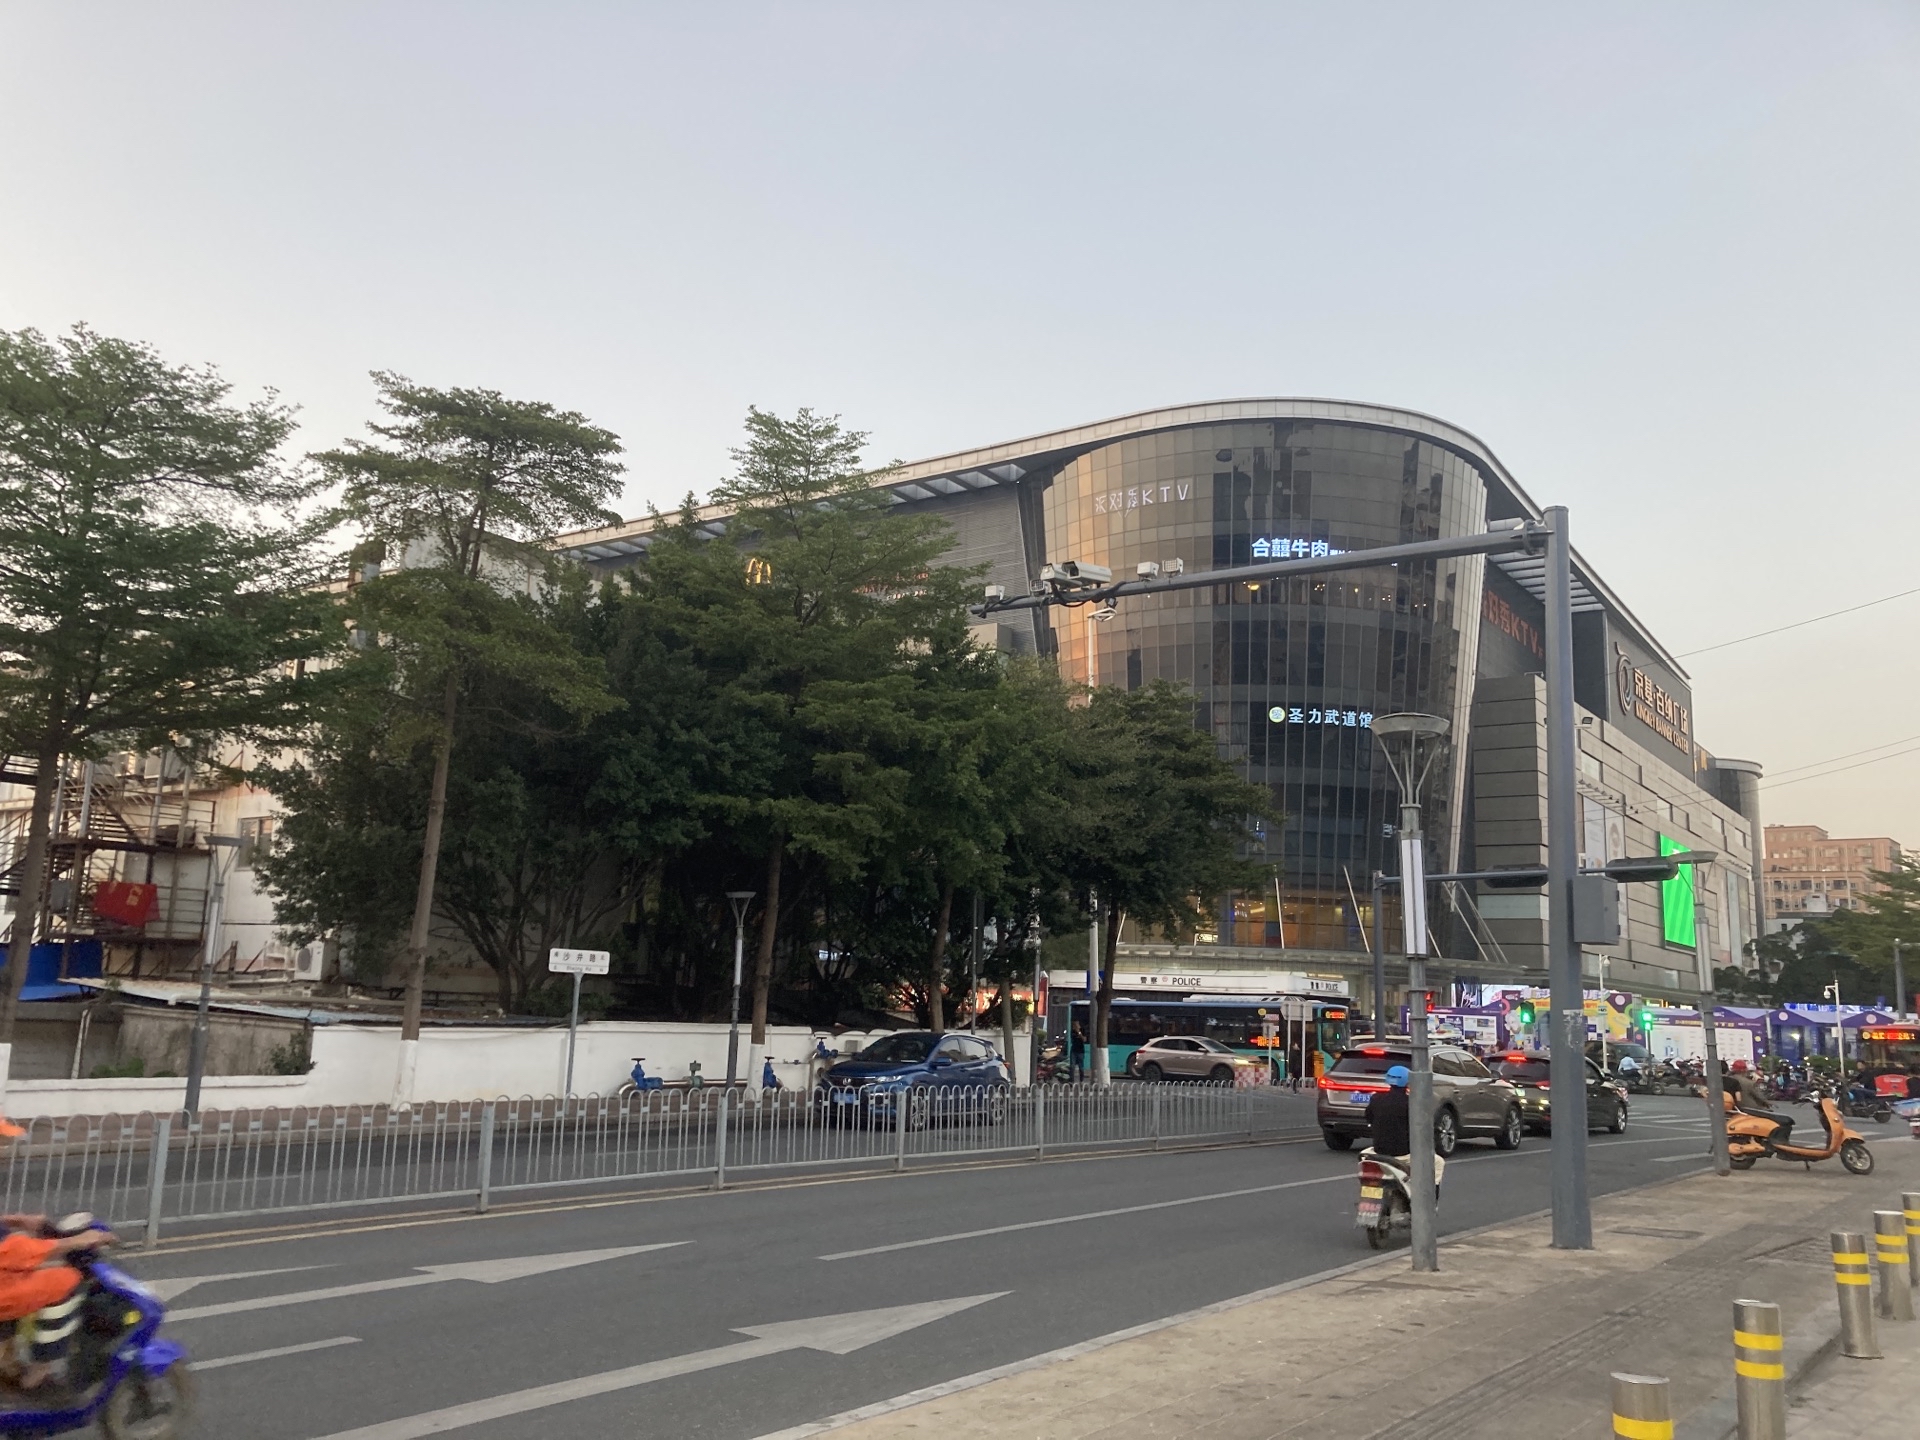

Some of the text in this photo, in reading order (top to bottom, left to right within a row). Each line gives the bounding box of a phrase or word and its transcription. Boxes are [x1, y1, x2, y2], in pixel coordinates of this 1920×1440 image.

[1252, 538, 1328, 558] 合囍牛肉
[1288, 708, 1373, 729] 圣力武道馆
[1673, 731, 1689, 755] CENTER
[1172, 977, 1201, 986] POLICE
